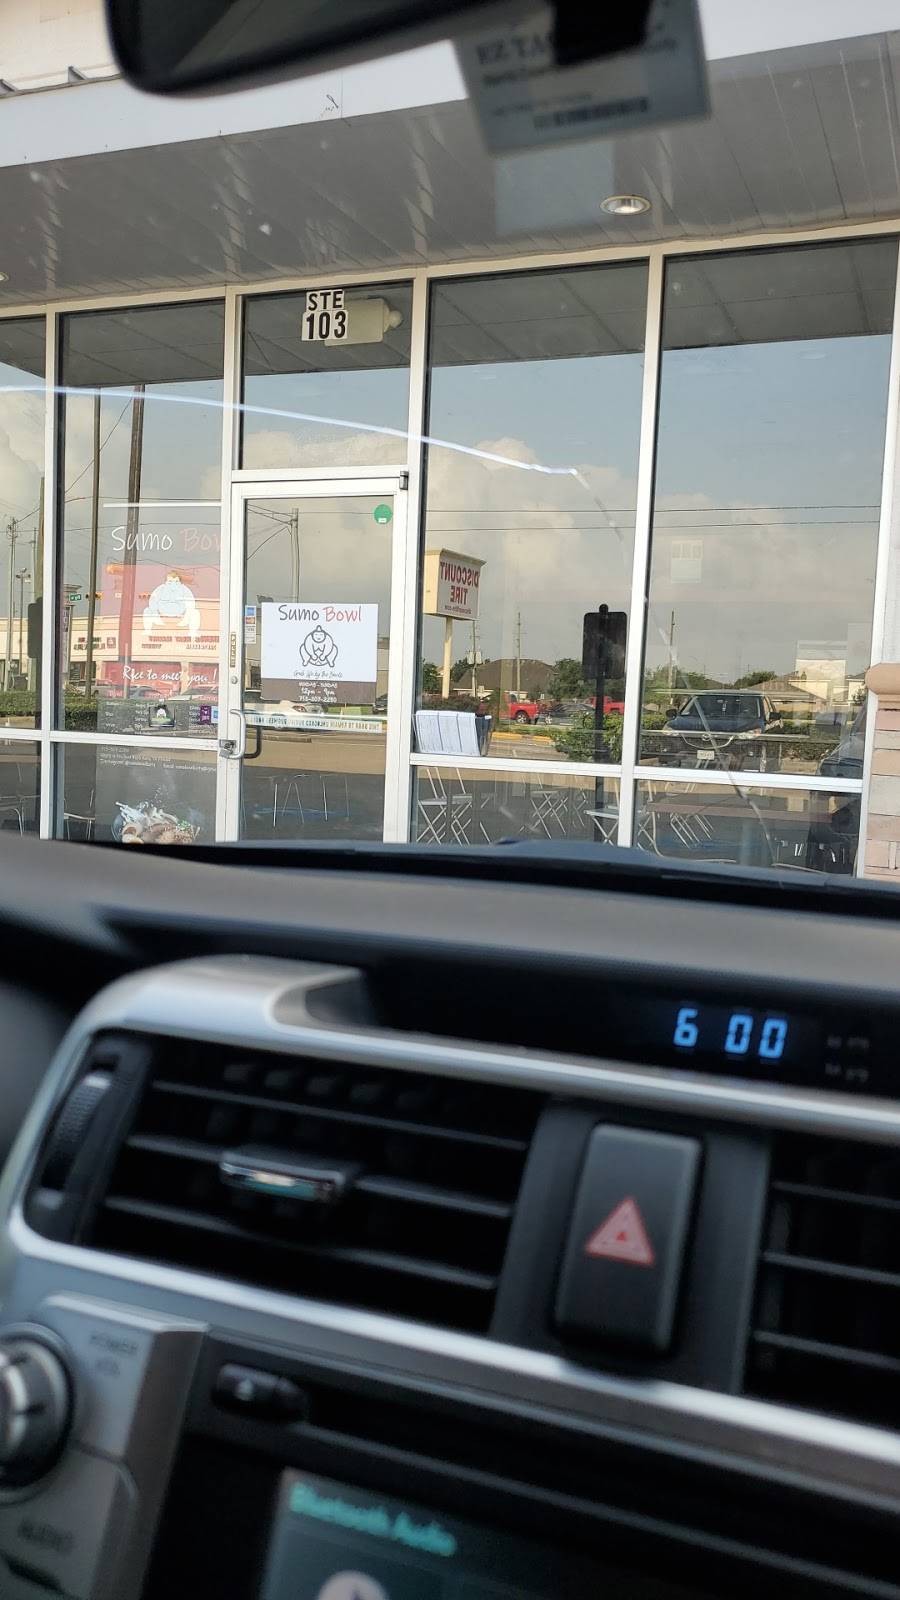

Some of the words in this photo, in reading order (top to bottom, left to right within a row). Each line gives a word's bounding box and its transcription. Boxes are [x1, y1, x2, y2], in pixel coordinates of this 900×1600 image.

[308, 290, 343, 311] STE
[306, 310, 347, 340] 103
[111, 525, 173, 551] Sumo
[278, 604, 320, 621] Sumo
[322, 605, 362, 622] Bowl
[123, 665, 145, 680] Rice
[147, 668, 158, 680] to
[161, 670, 183, 681] meet
